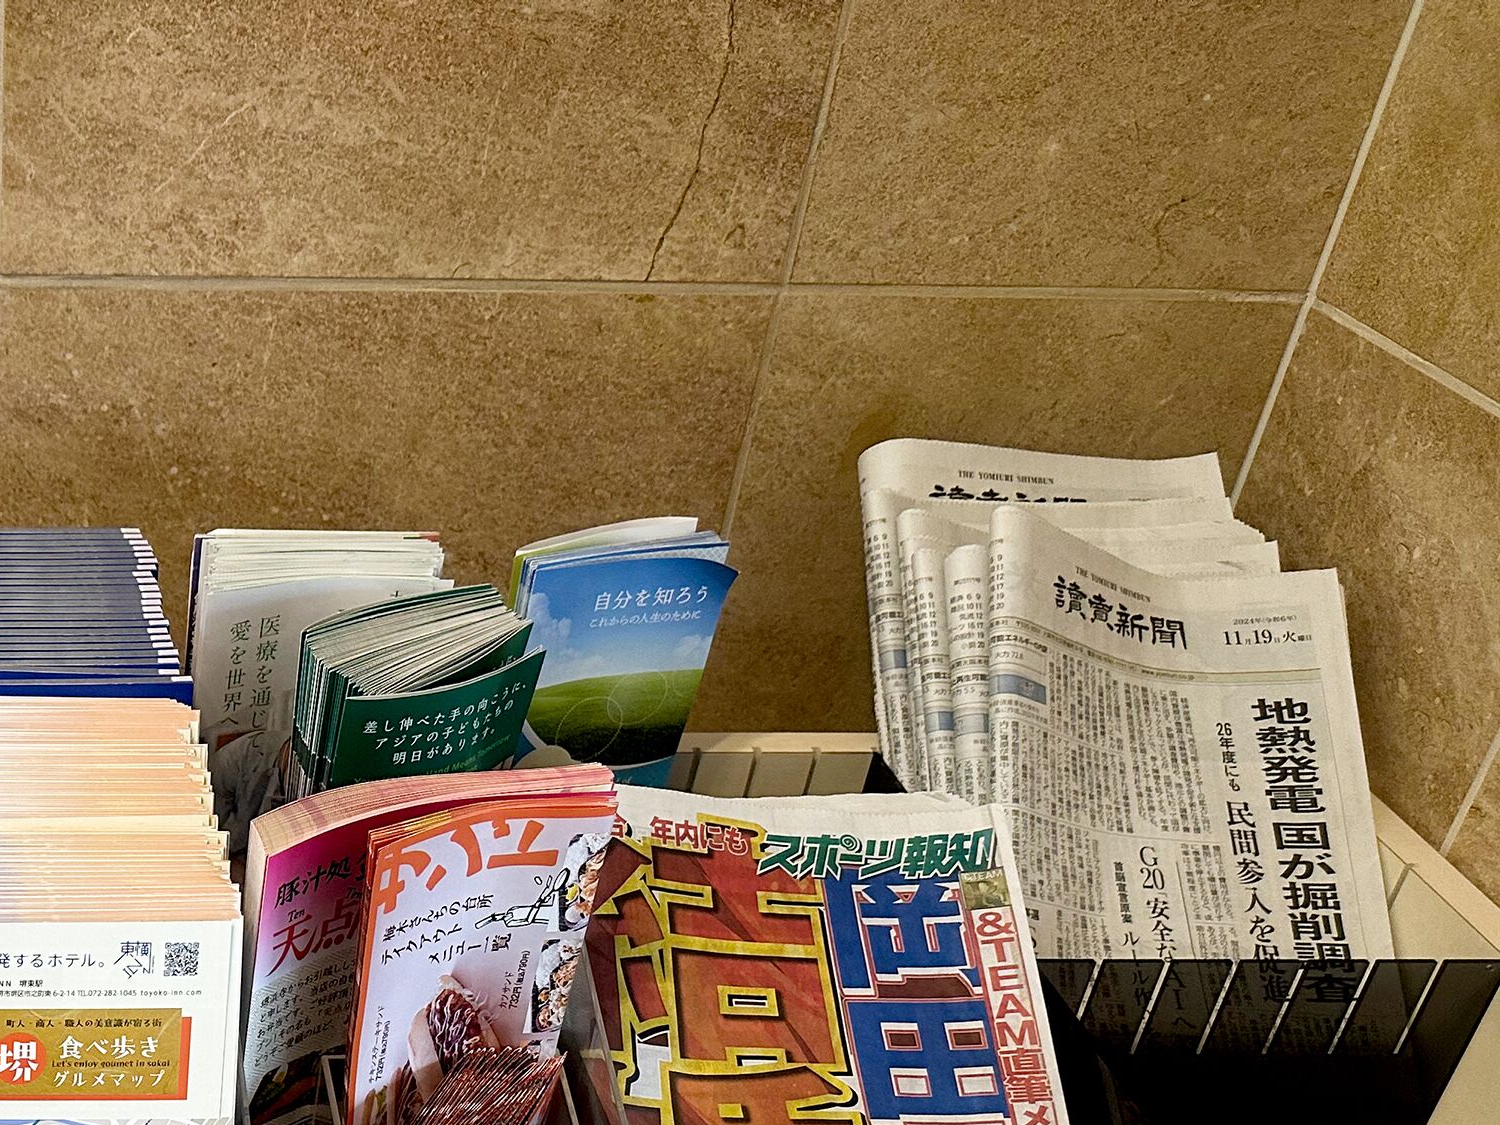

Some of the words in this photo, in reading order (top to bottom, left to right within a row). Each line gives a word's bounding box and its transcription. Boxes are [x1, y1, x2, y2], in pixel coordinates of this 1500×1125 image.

[958, 470, 975, 480] THE
[978, 471, 1015, 482] YOMIURI
[1017, 474, 1054, 485] SHIMBUN
[590, 610, 702, 629] これからの人生のために
[594, 586, 709, 612] 自分を知ろう
[1053, 576, 1188, 650] 讀賣新聞
[221, 620, 251, 726] 愛を世界へ
[247, 615, 281, 757] 医療を通じて、
[363, 682, 527, 735] 差し伸べた手の向こうに、
[375, 700, 514, 750] アジアの子どもたちの
[392, 728, 496, 766] 明日があります。
[1216, 723, 1241, 792] 26年度にも
[1251, 697, 1327, 814] 地熱発電
[649, 814, 749, 857] 年内にも
[757, 828, 996, 882] スポーツ報知
[374, 818, 560, 916] サンド
[383, 893, 495, 943] 梅木さんちの台所
[1226, 800, 1290, 1003] 民間参入を促進
[1272, 821, 1358, 1003] 国が掘削調査
[266, 896, 362, 978] 天点
[381, 923, 464, 966] テイクアウト
[428, 932, 513, 964] メニュー一覧
[19, 979, 44, 988] 堺東駅
[140, 989, 202, 997] toyoko-inn.com
[499, 971, 515, 1009] カツサンド
[52, 1059, 72, 1068] Let's
[74, 1060, 98, 1069] enjoy
[100, 1060, 133, 1068] gourmet
[58, 1035, 159, 1060] 食べ歩き
[369, 1004, 384, 1084] チキンステーキサンド
[53, 1070, 166, 1088] グルメマップ
